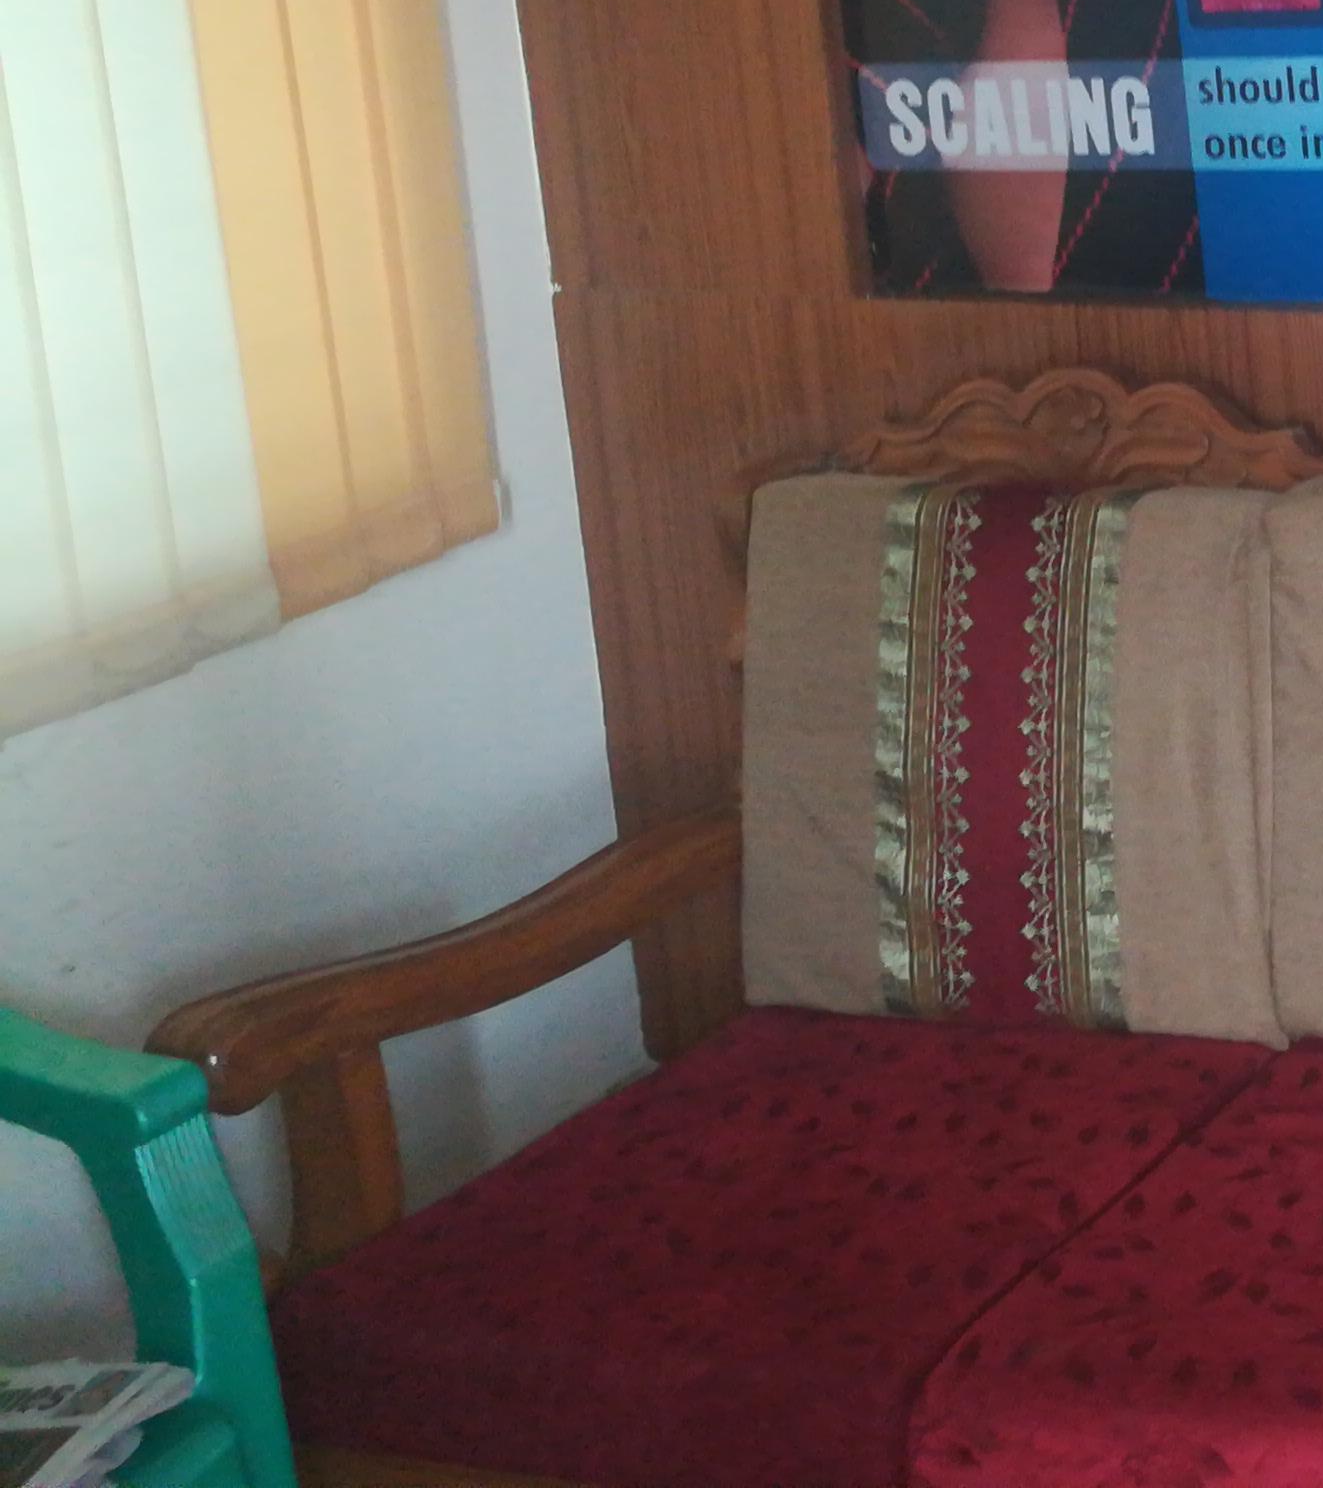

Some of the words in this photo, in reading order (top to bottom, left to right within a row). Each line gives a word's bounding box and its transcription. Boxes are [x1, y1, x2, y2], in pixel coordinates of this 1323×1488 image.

[1198, 61, 1320, 108] should
[885, 72, 1155, 160] SCALING
[1204, 123, 1288, 162] once
